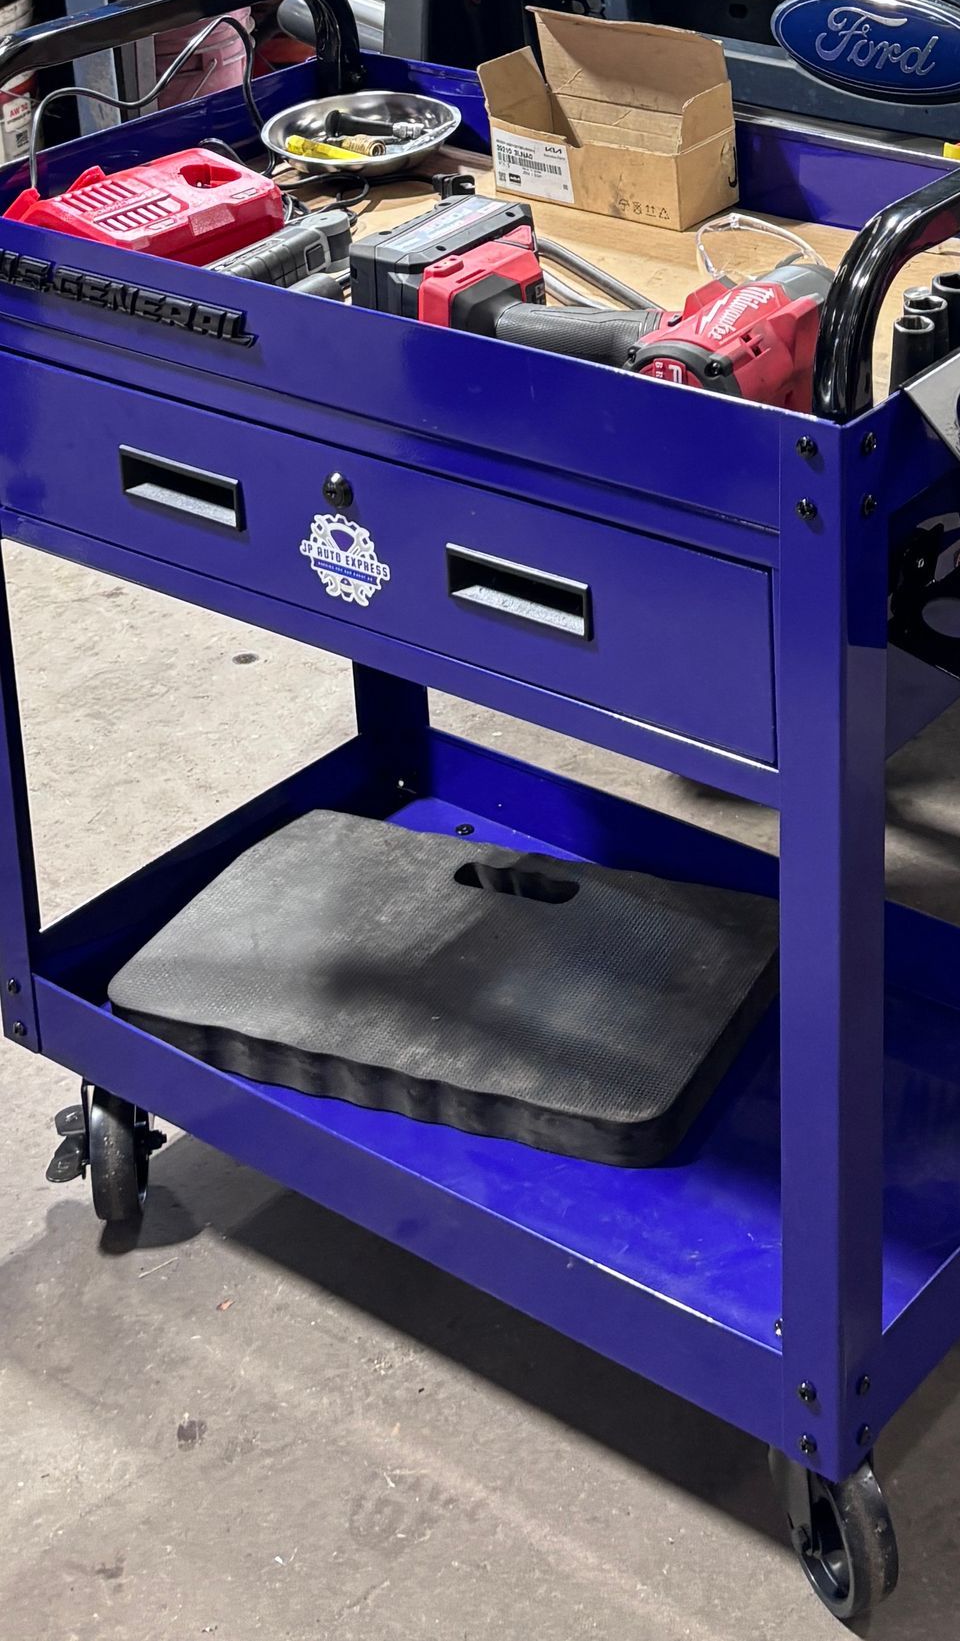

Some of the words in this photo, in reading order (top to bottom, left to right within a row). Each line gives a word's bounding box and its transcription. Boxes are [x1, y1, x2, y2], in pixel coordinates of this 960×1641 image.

[815, 6, 940, 76] Ford
[54, 265, 258, 349] GENERAL
[707, 285, 776, 342] Milwaukee
[302, 542, 313, 554] JP
[317, 546, 342, 563] AUTO
[345, 555, 388, 578] EXPRESS
